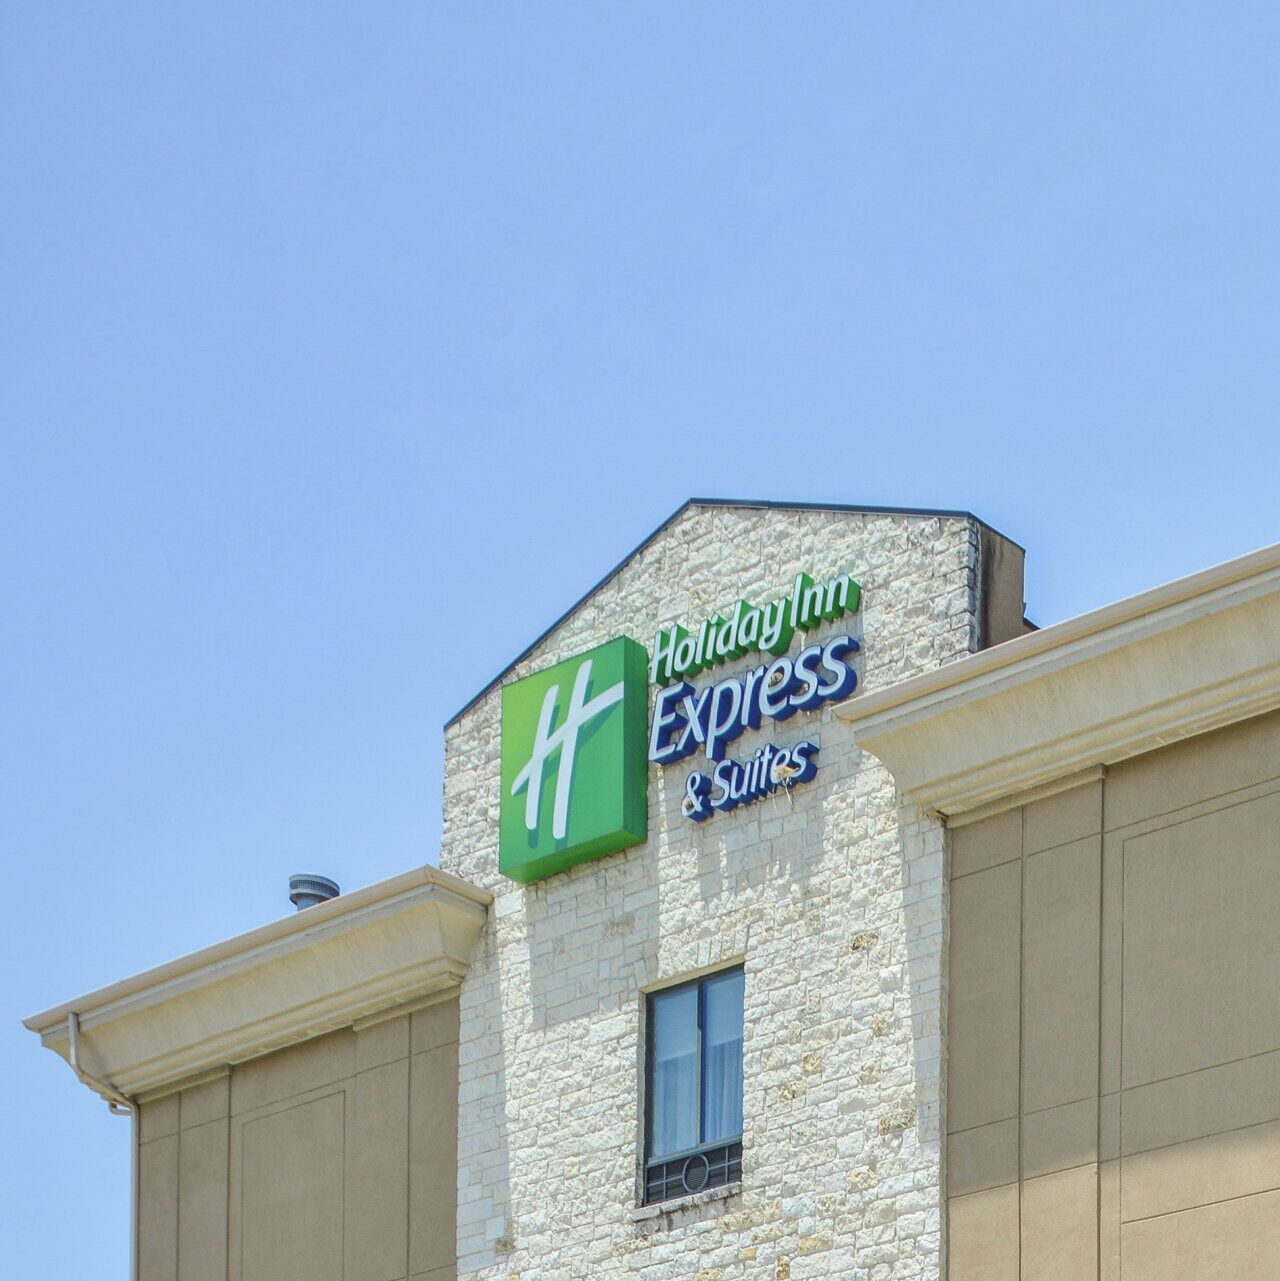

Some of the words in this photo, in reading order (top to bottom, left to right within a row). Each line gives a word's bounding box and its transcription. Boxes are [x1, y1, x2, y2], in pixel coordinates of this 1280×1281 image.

[649, 598, 794, 685] Holiday
[790, 571, 858, 630] Inn
[647, 635, 859, 765] Express
[681, 771, 712, 821] &
[710, 740, 819, 812] Suites
